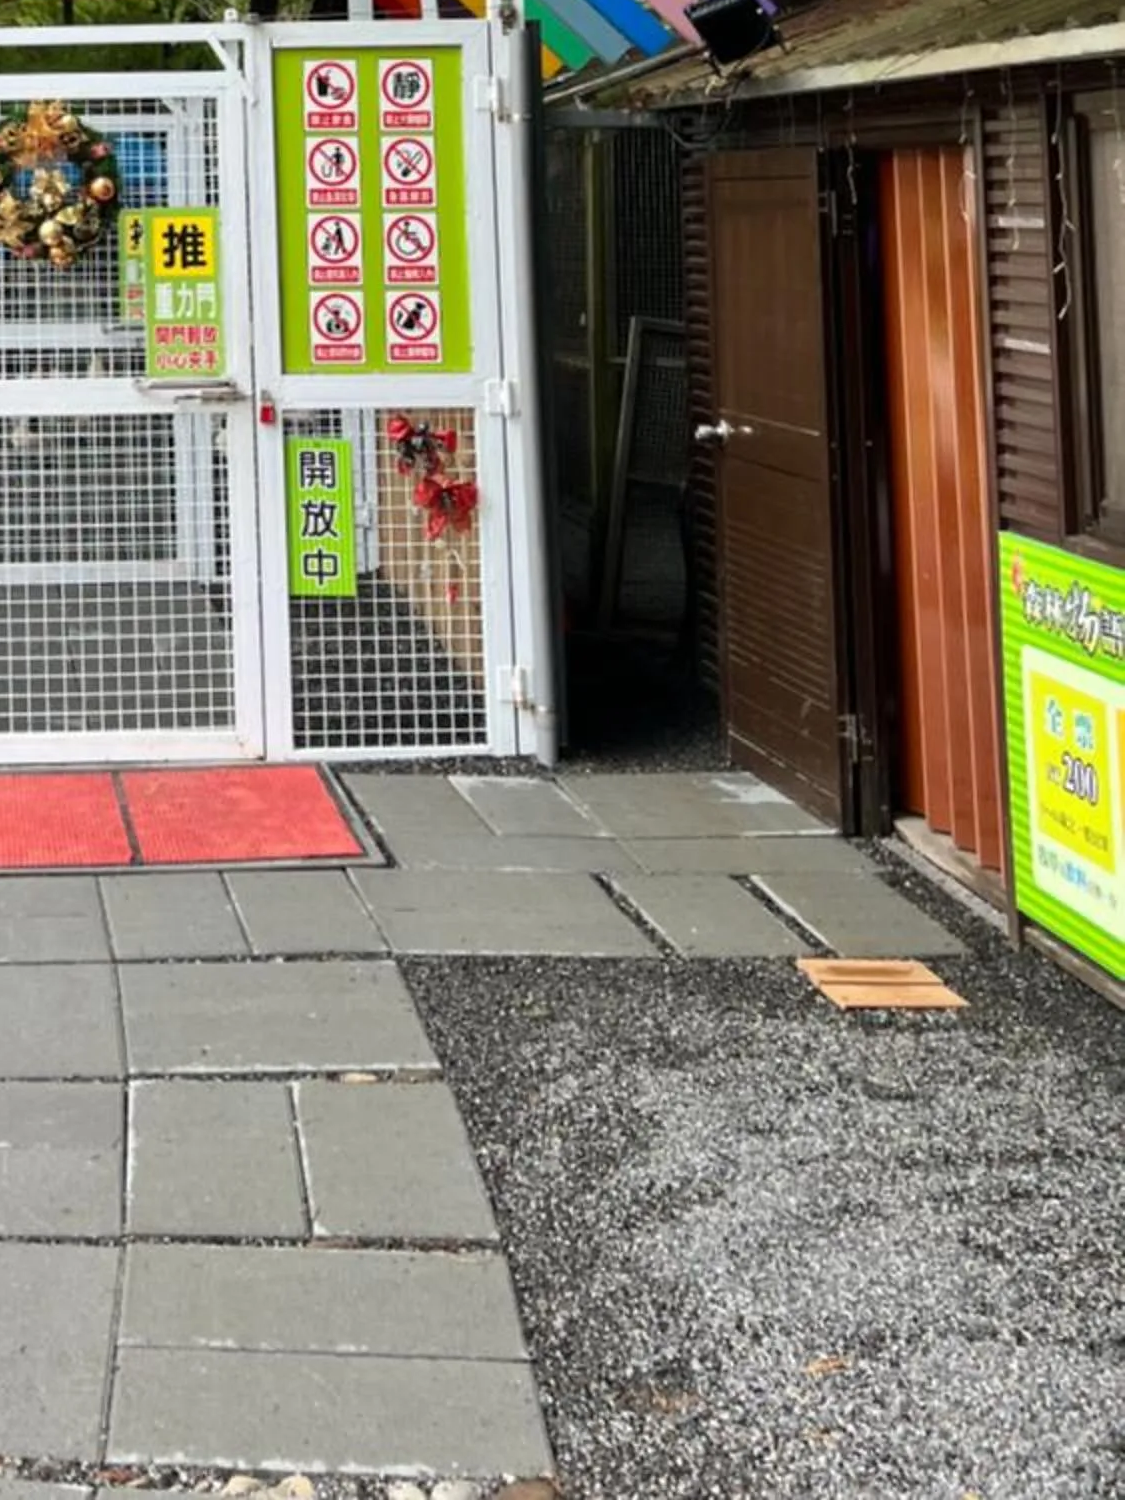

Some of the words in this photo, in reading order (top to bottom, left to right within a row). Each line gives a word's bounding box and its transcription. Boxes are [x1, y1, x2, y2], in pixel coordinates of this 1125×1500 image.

[161, 223, 207, 269] 推
[155, 282, 216, 320] 重力門
[300, 451, 339, 585] 開放中
[1061, 750, 1099, 806] 200
